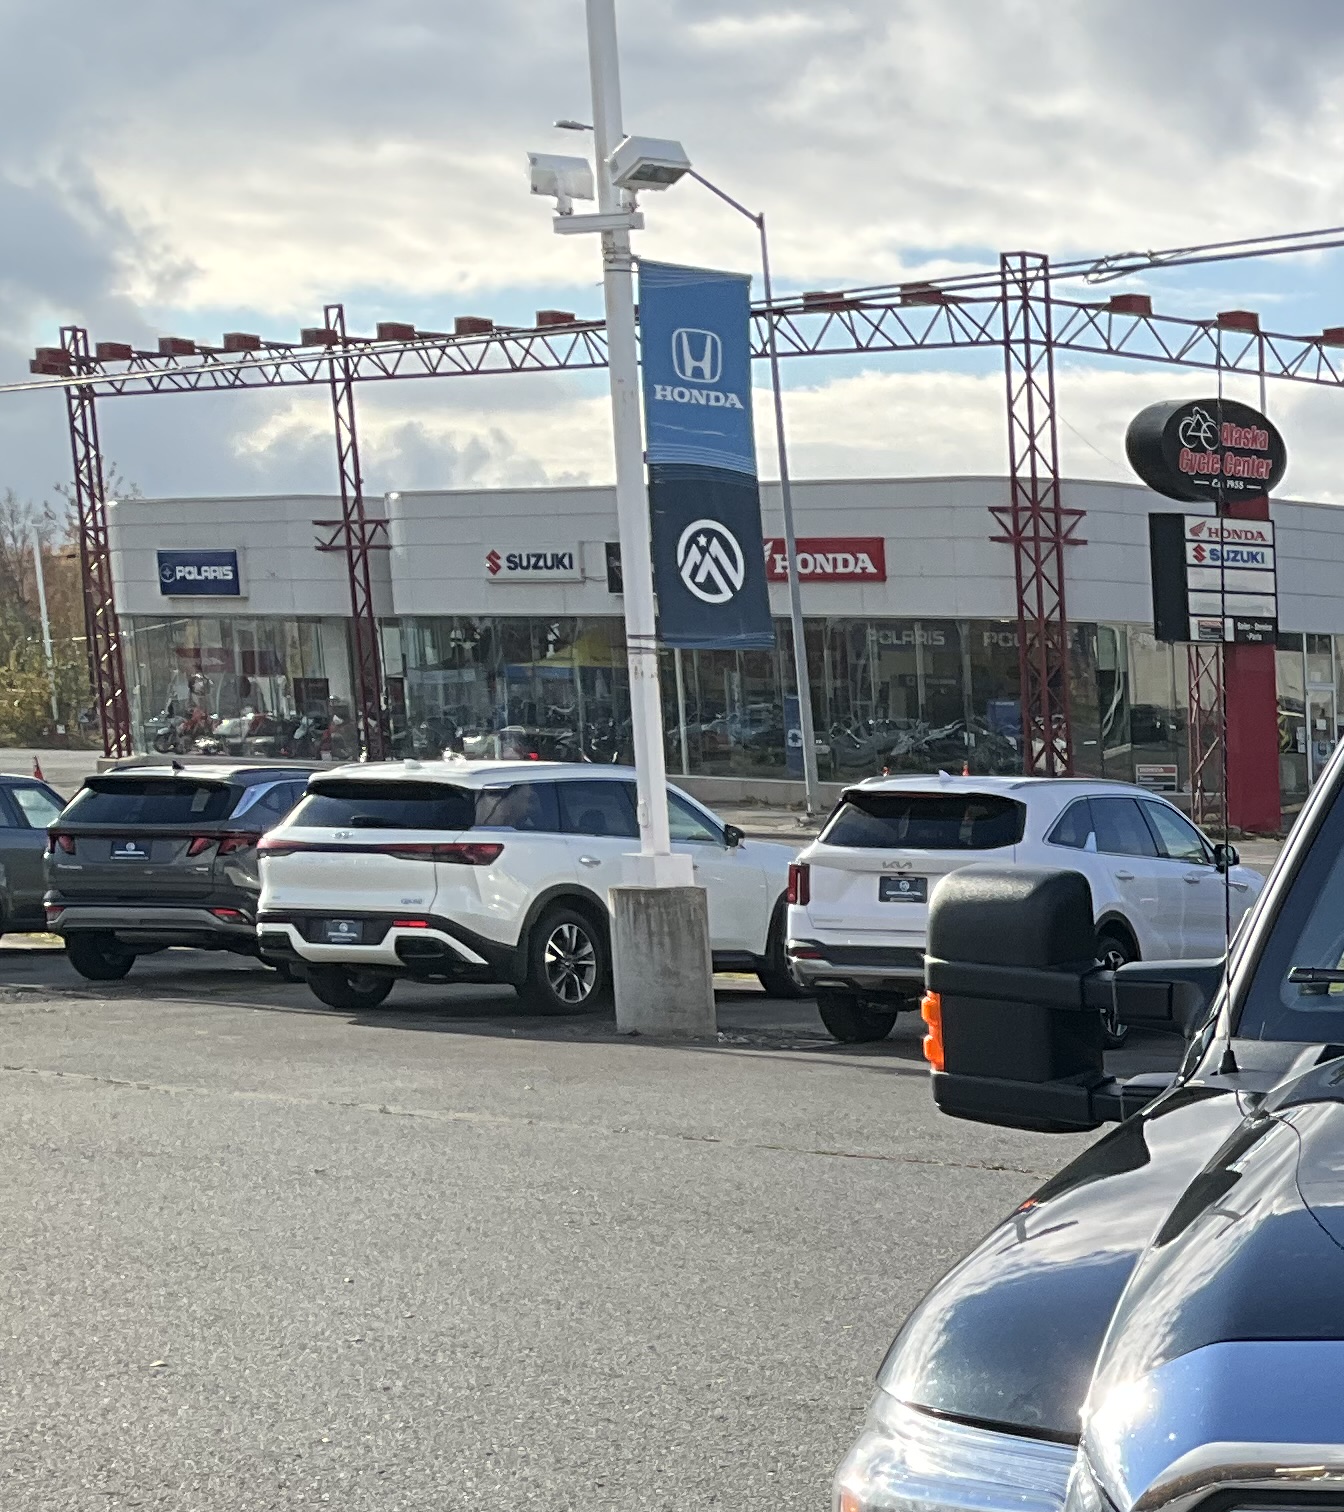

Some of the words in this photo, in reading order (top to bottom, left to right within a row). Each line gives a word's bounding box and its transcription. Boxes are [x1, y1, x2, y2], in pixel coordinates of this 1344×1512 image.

[653, 384, 744, 409] HONDA
[1221, 422, 1269, 450] Alaska
[1179, 448, 1221, 475] Cycle
[1222, 452, 1272, 480] Center
[1207, 527, 1266, 541] HONDA
[506, 552, 574, 570] SUZUKI
[773, 553, 878, 573] HONDA
[1209, 548, 1265, 564] SUZUKI
[175, 566, 234, 580] POLARIS
